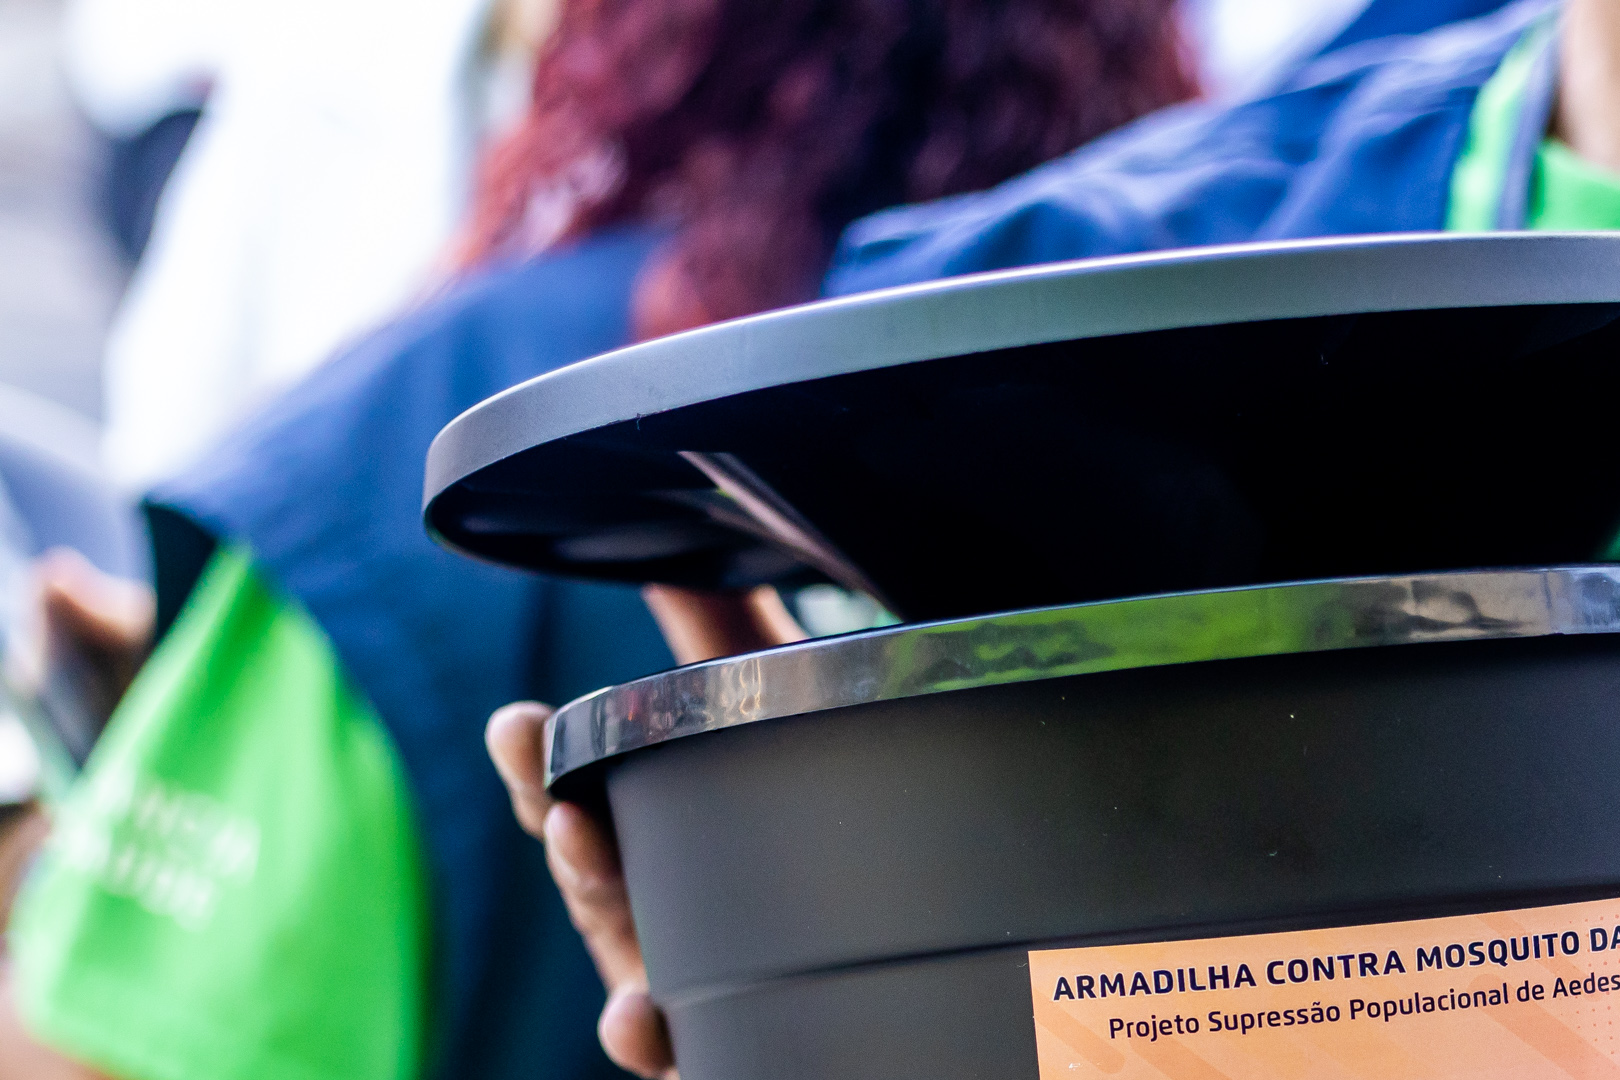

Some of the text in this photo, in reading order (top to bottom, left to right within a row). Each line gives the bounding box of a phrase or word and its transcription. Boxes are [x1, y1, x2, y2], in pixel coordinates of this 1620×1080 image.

[1053, 962, 1257, 1001] ARMADILHA
[1266, 949, 1406, 985] CONTRA
[1416, 930, 1580, 972] MOSQUITO
[1108, 1014, 1200, 1042] Projeto
[1208, 1001, 1341, 1035] Supressão
[1349, 982, 1510, 1022] Populacional
[1516, 980, 1546, 1003] de
